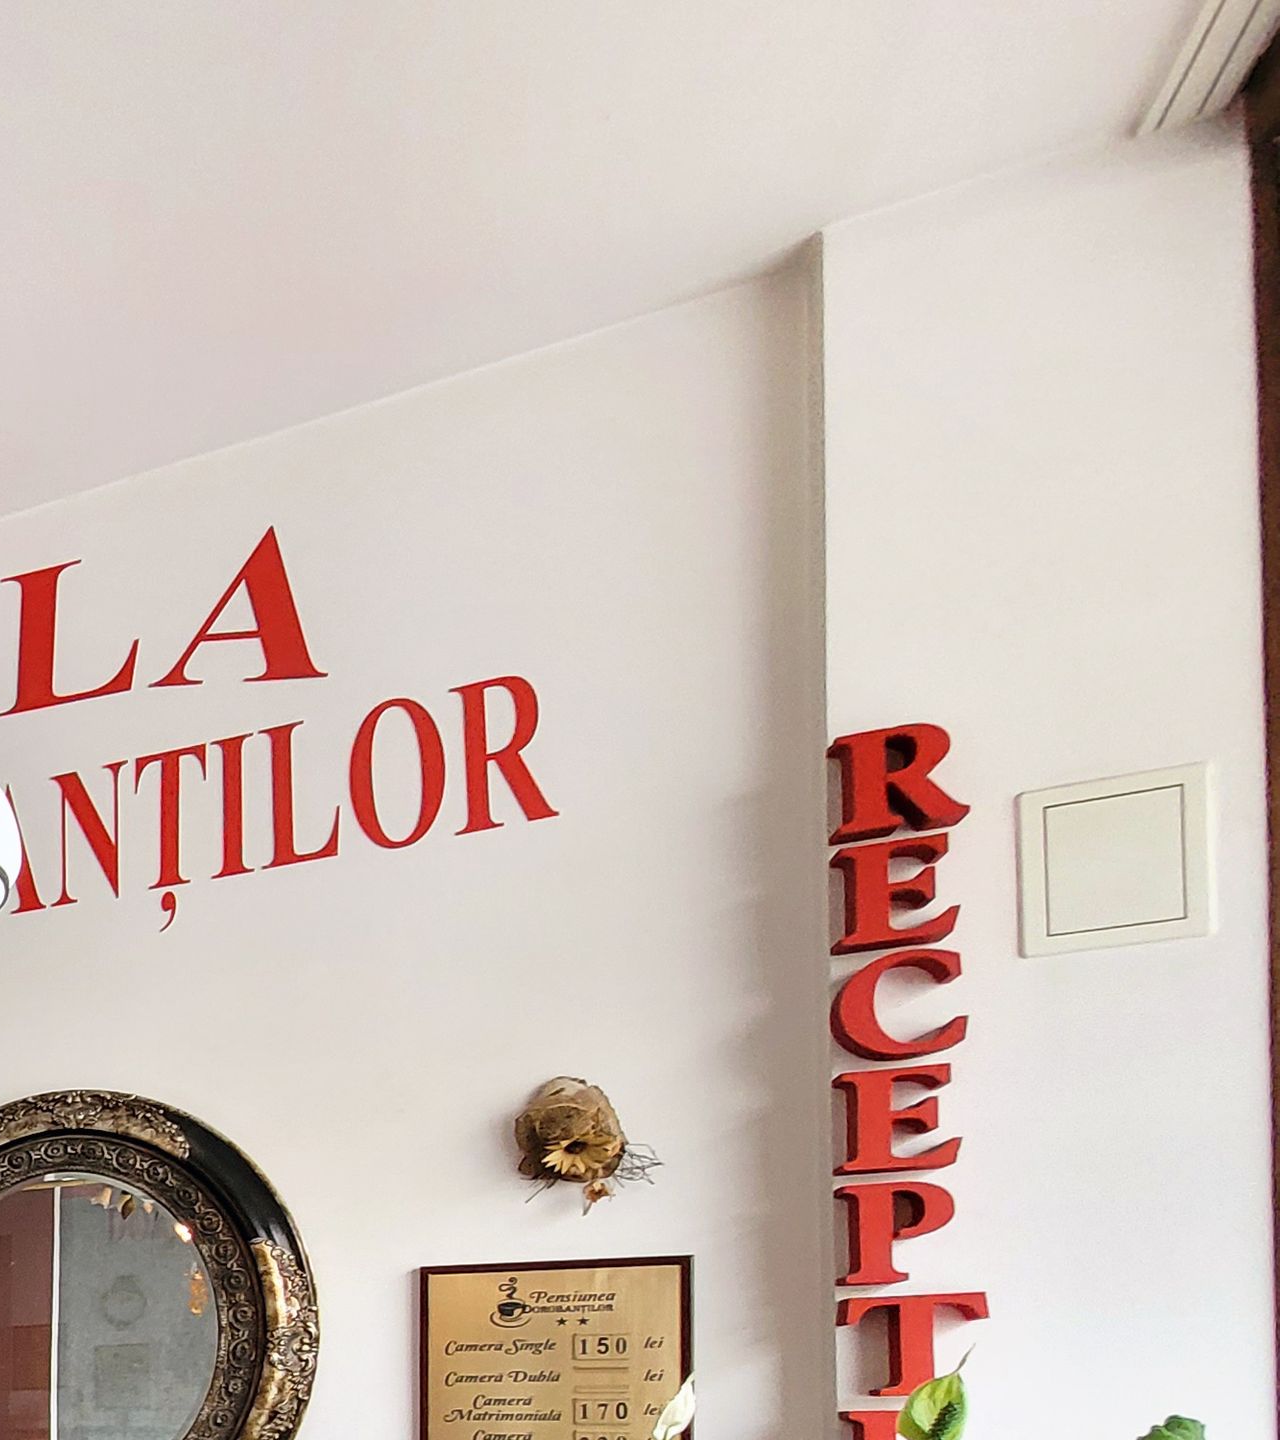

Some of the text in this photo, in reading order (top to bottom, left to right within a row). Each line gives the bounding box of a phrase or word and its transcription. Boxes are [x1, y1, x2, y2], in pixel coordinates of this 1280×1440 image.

[529, 1291, 617, 1305] Pensiunea
[504, 1338, 558, 1355] Single
[579, 1336, 628, 1355] 150
[643, 1336, 665, 1350] lei
[643, 1369, 665, 1382] lei
[580, 1401, 628, 1420] 170
